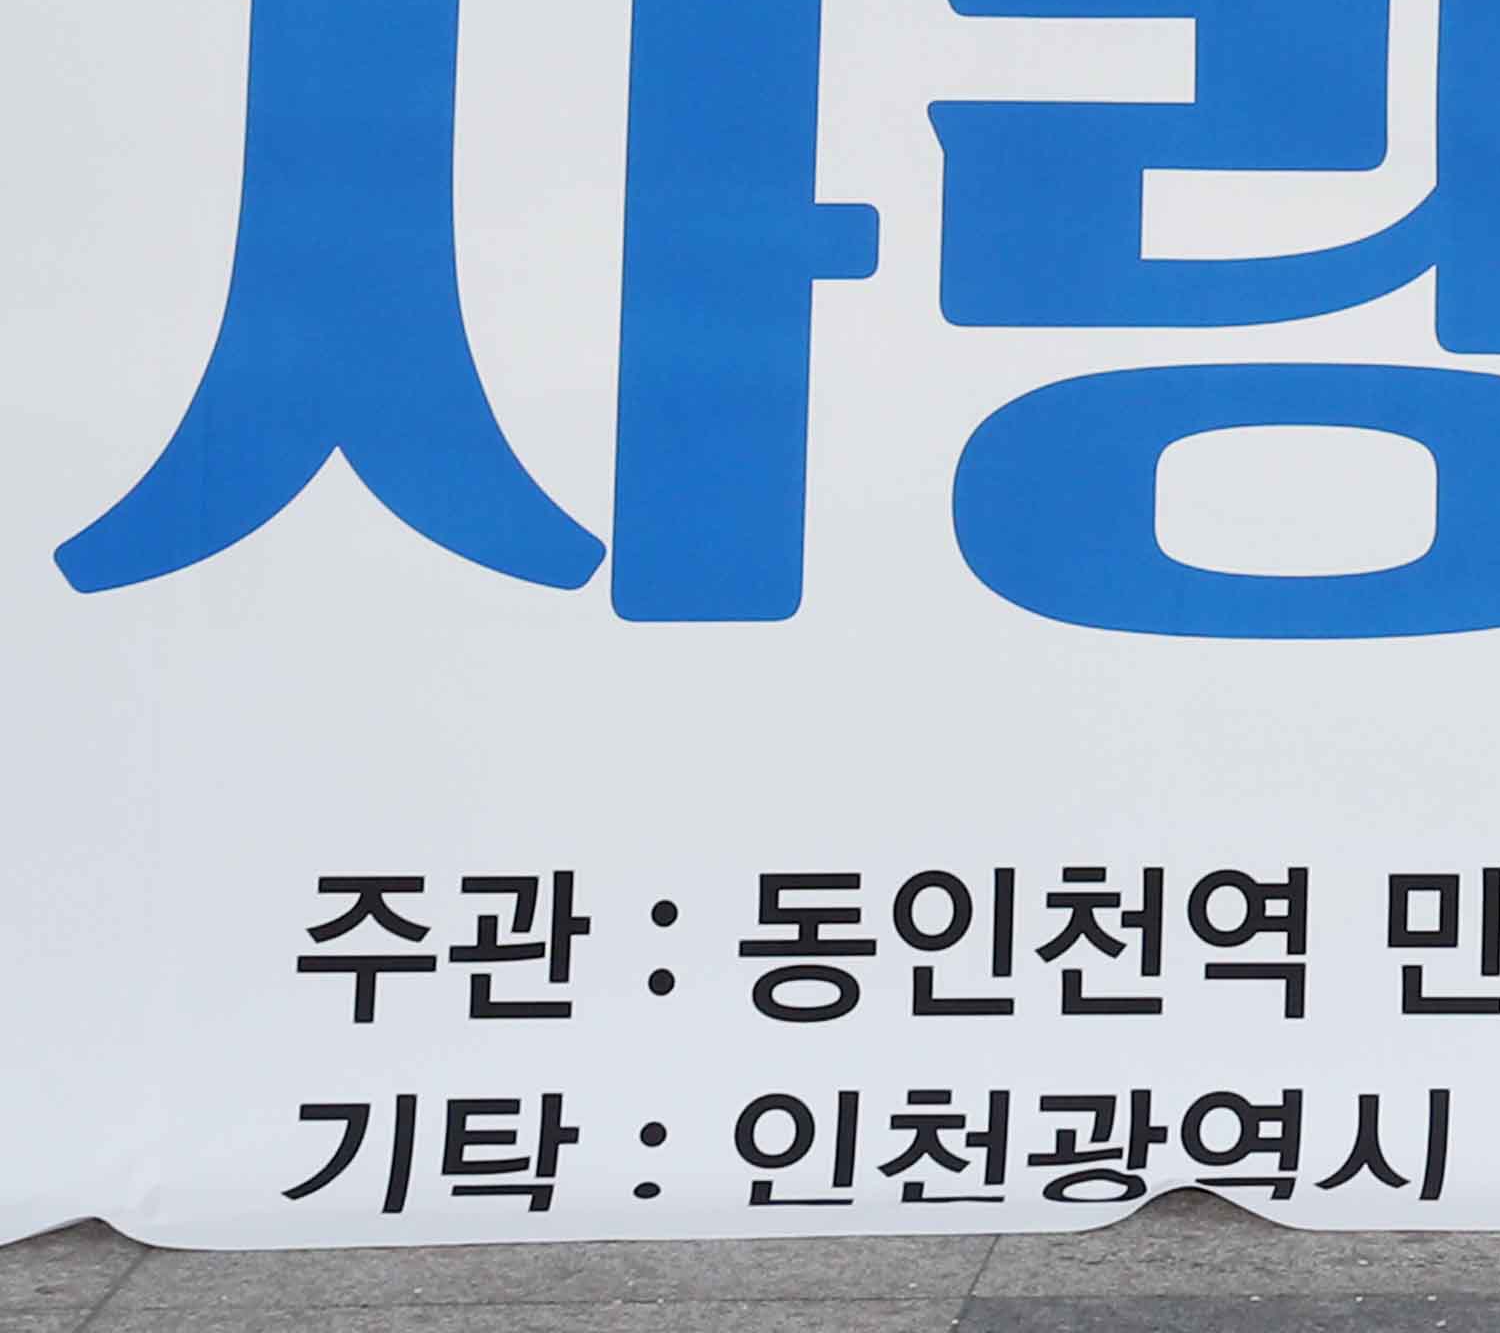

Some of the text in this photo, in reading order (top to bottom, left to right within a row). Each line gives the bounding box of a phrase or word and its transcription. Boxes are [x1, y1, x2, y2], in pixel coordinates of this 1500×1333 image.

[296, 868, 591, 1024] 주관
[738, 866, 1309, 1023] 동인천역
[281, 1092, 580, 1214] 기탁
[733, 1088, 1452, 1206] 인천광역시
